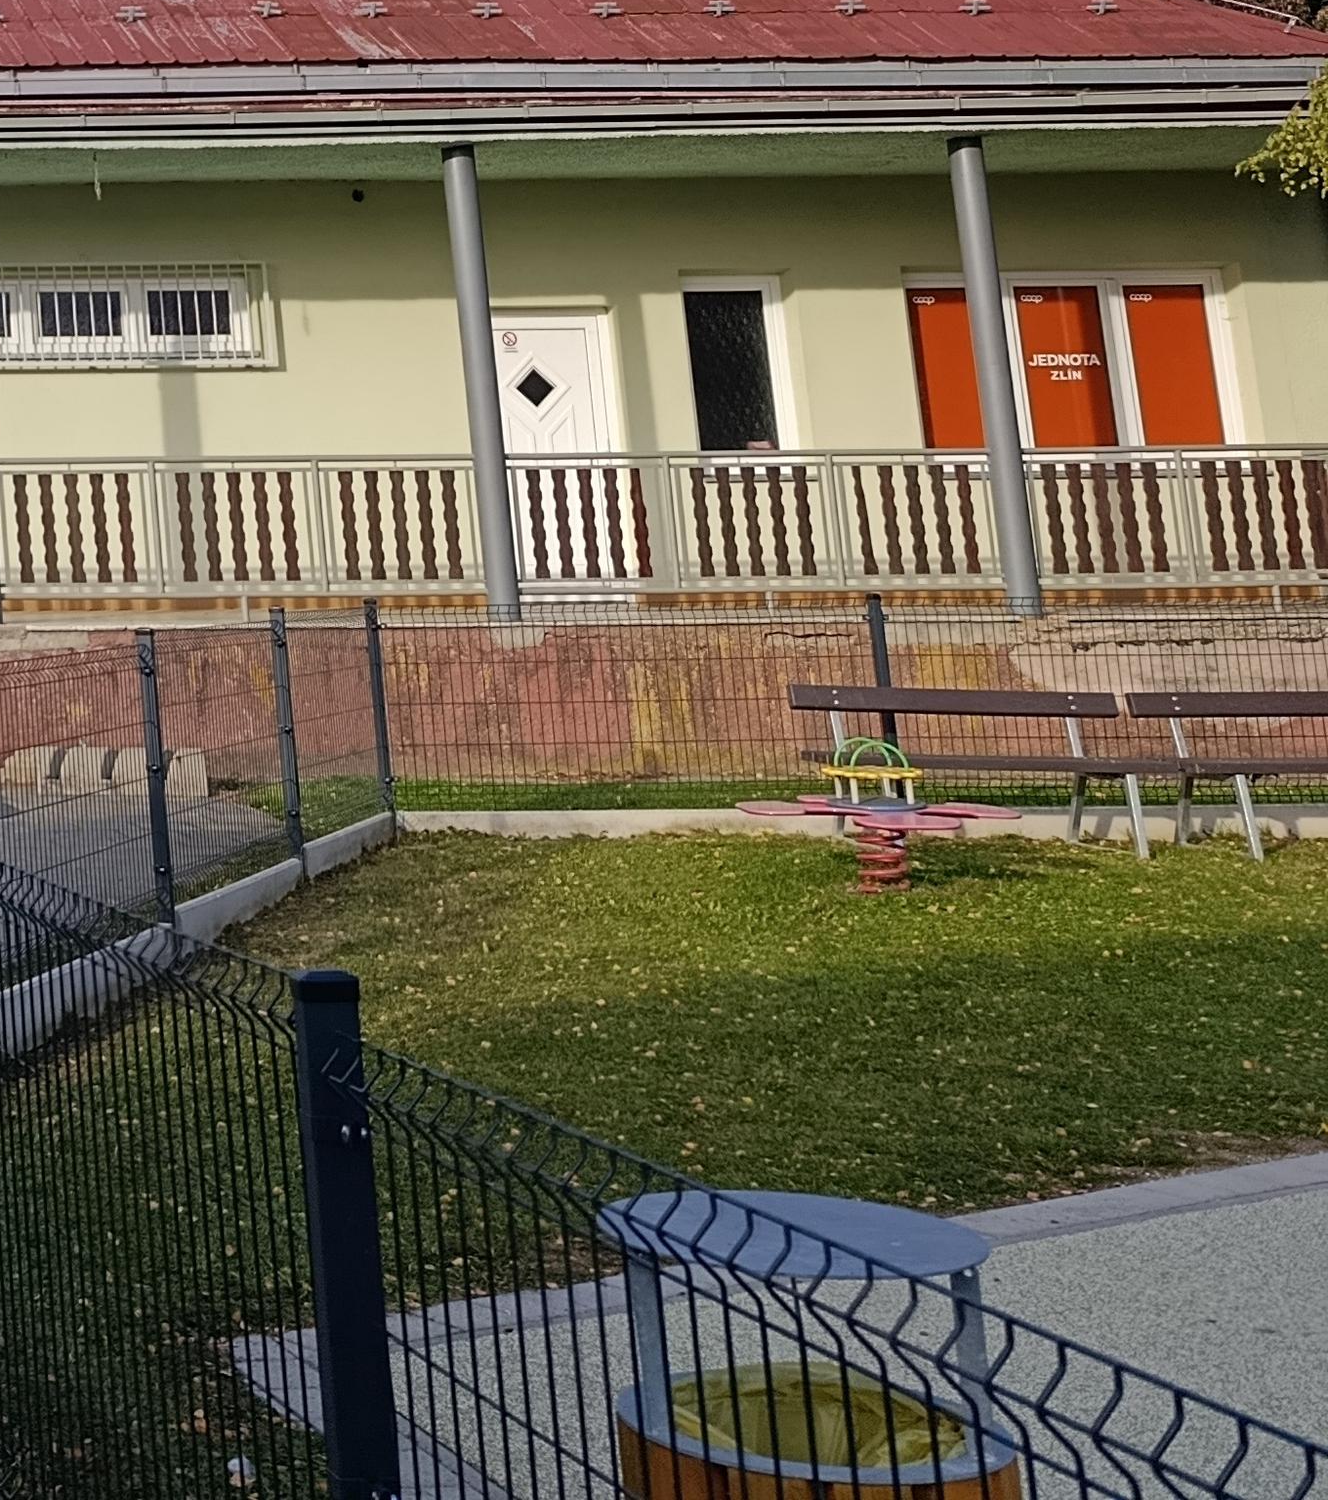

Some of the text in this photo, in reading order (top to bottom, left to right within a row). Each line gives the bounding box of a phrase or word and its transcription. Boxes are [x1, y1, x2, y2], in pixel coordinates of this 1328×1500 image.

[912, 295, 935, 305] coop
[1020, 294, 1043, 304] coop
[1129, 293, 1152, 303] coop
[1028, 354, 1101, 367] JEDNOTA
[1050, 369, 1082, 380] ZLÍN
